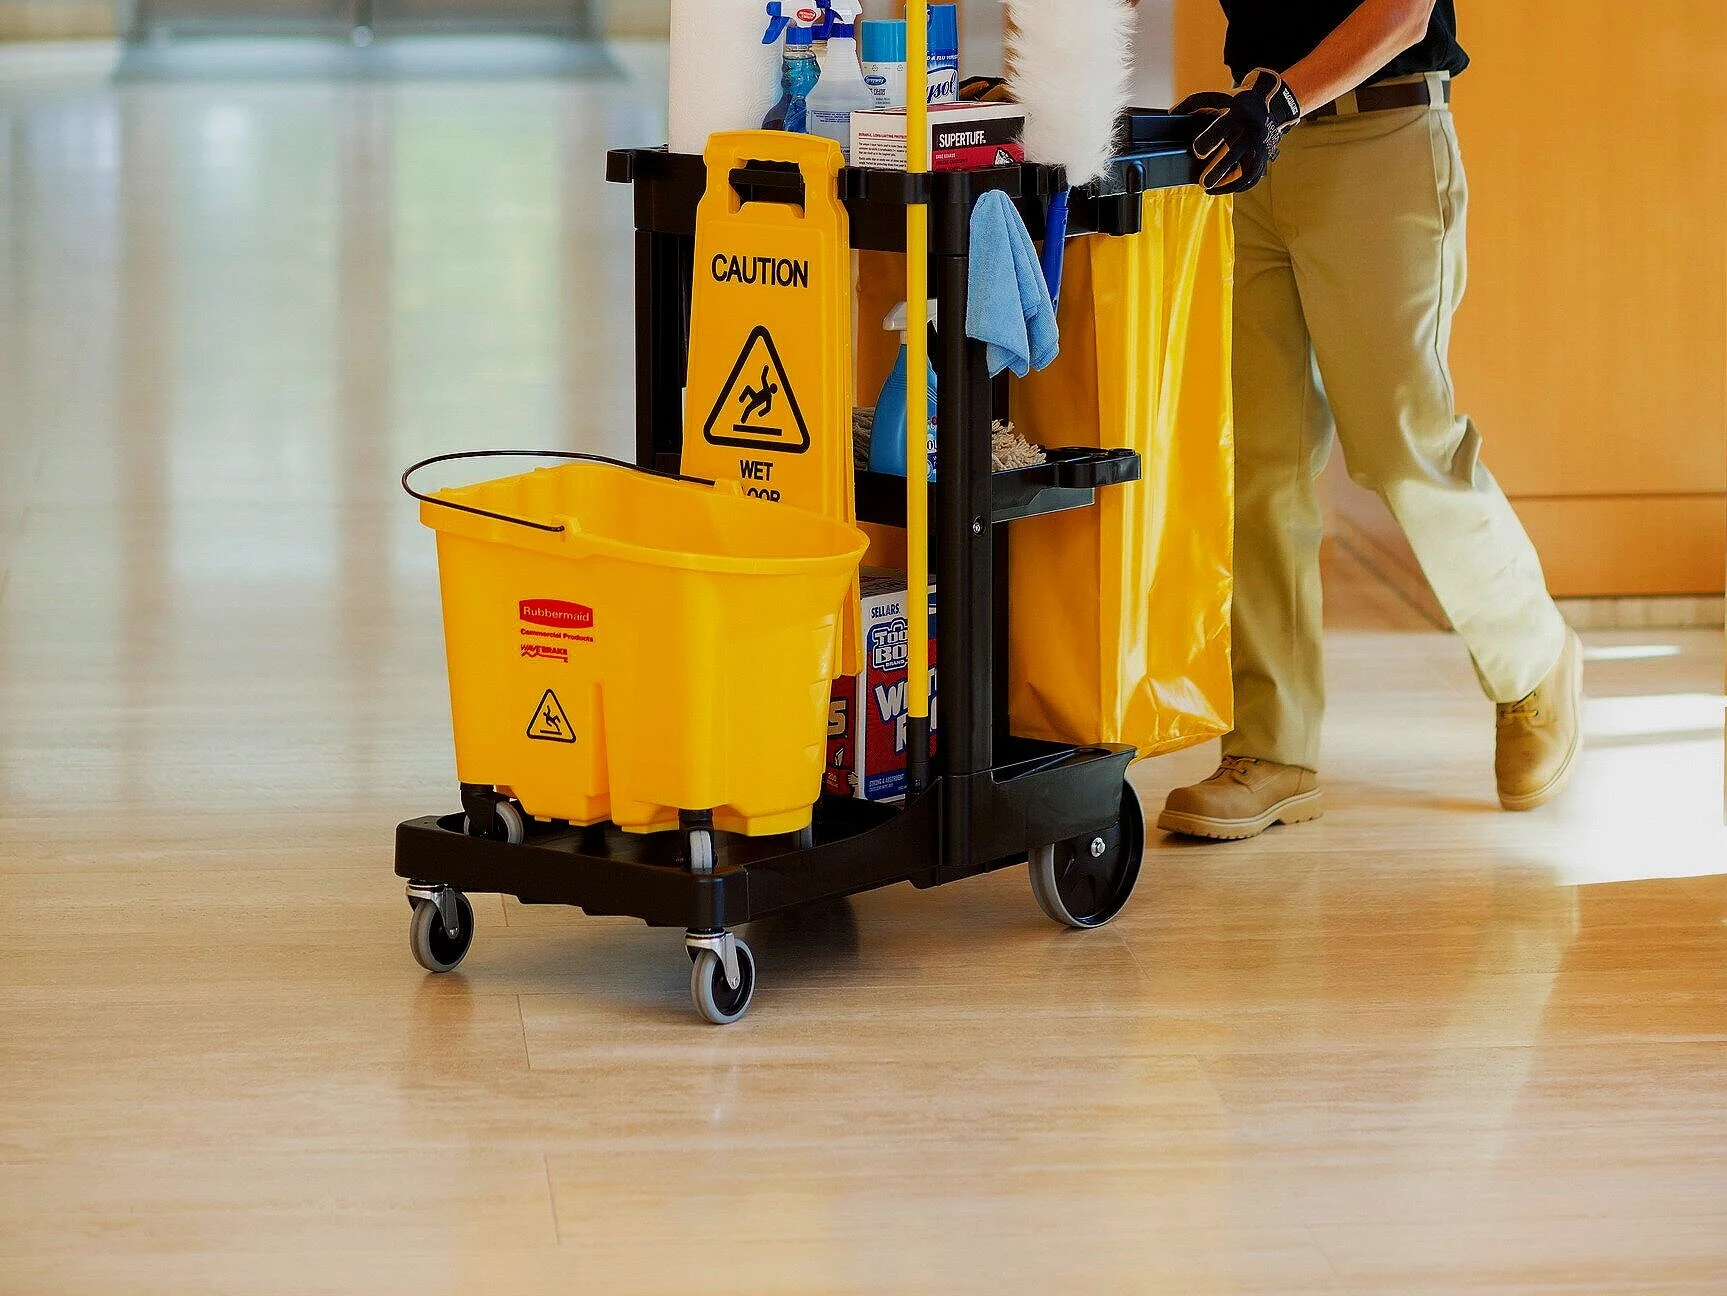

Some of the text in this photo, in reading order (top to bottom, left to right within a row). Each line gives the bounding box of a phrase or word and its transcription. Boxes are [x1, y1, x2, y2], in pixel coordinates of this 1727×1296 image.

[926, 70, 956, 103] ysol
[939, 131, 985, 147] SUPERTUFF
[711, 253, 808, 288] CAUTION
[740, 459, 774, 481] WET
[523, 606, 590, 621] Rubbermaid
[870, 603, 900, 619] SELLARS
[520, 628, 593, 642] Commercial Products
[875, 644, 908, 664] BO
[885, 659, 905, 667] BRAND
